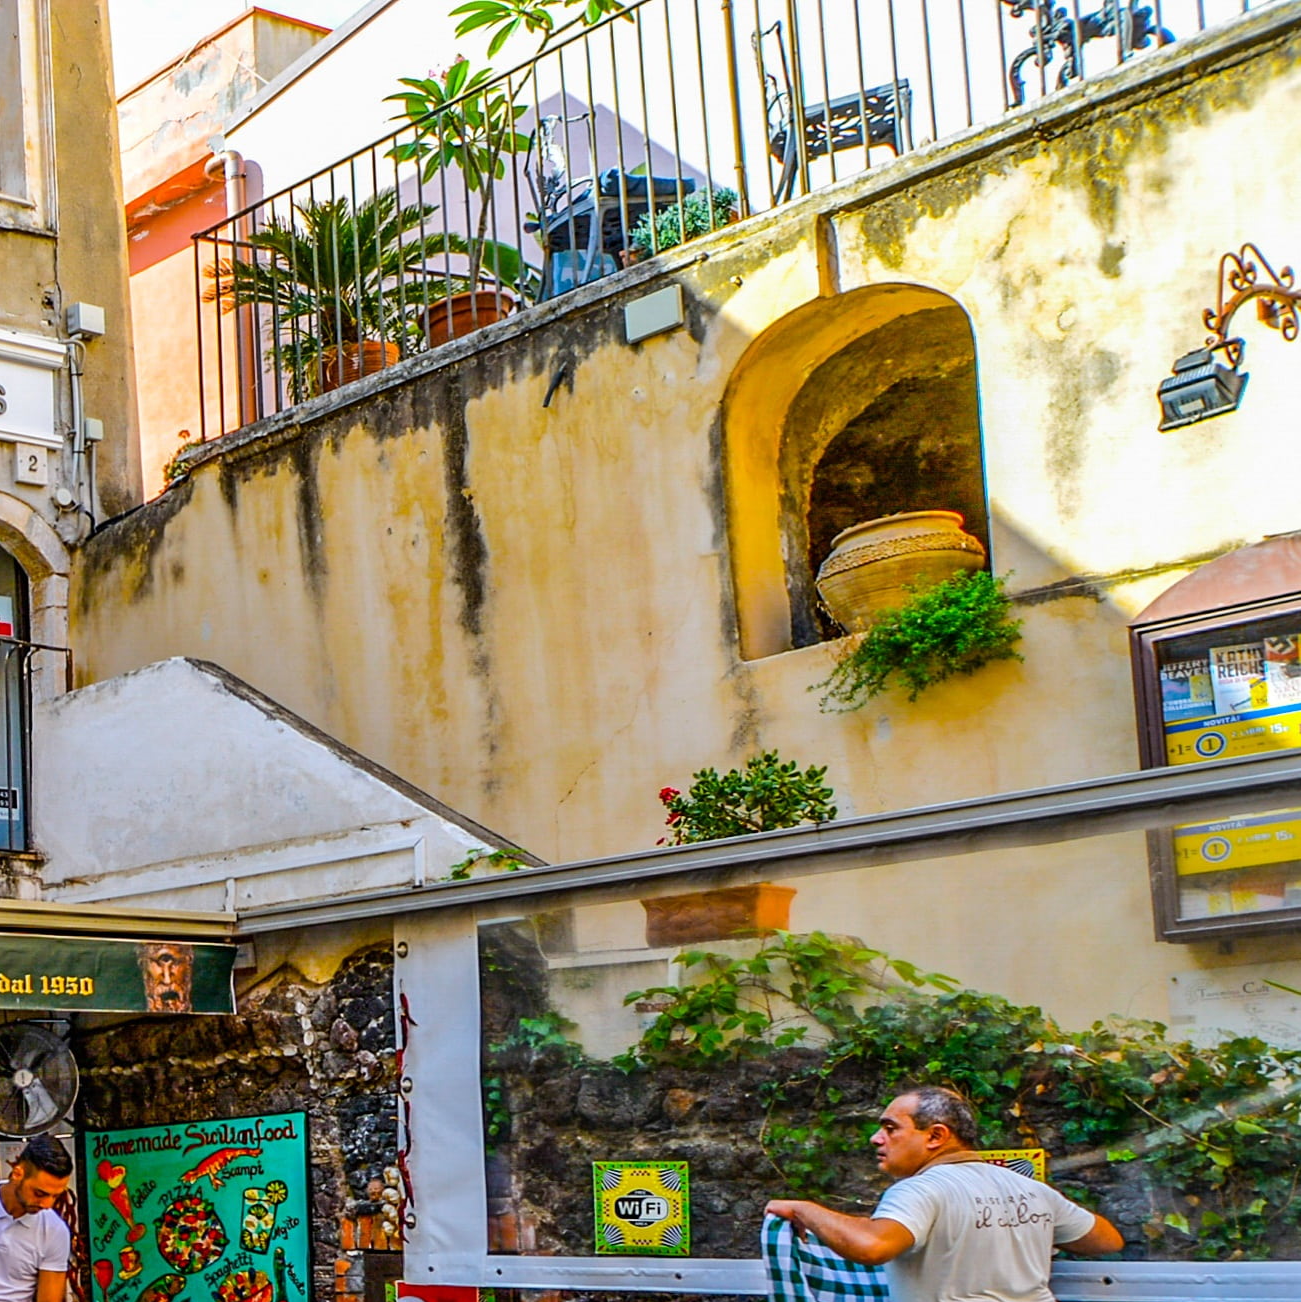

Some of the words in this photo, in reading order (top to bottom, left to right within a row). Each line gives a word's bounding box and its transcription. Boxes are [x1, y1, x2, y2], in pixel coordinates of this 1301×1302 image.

[27, 454, 39, 473] 2
[1218, 660, 1265, 679] REICHS
[40, 975, 94, 997] 1950
[91, 1129, 183, 1158] Homemade
[203, 1251, 255, 1288] Spaghetti
